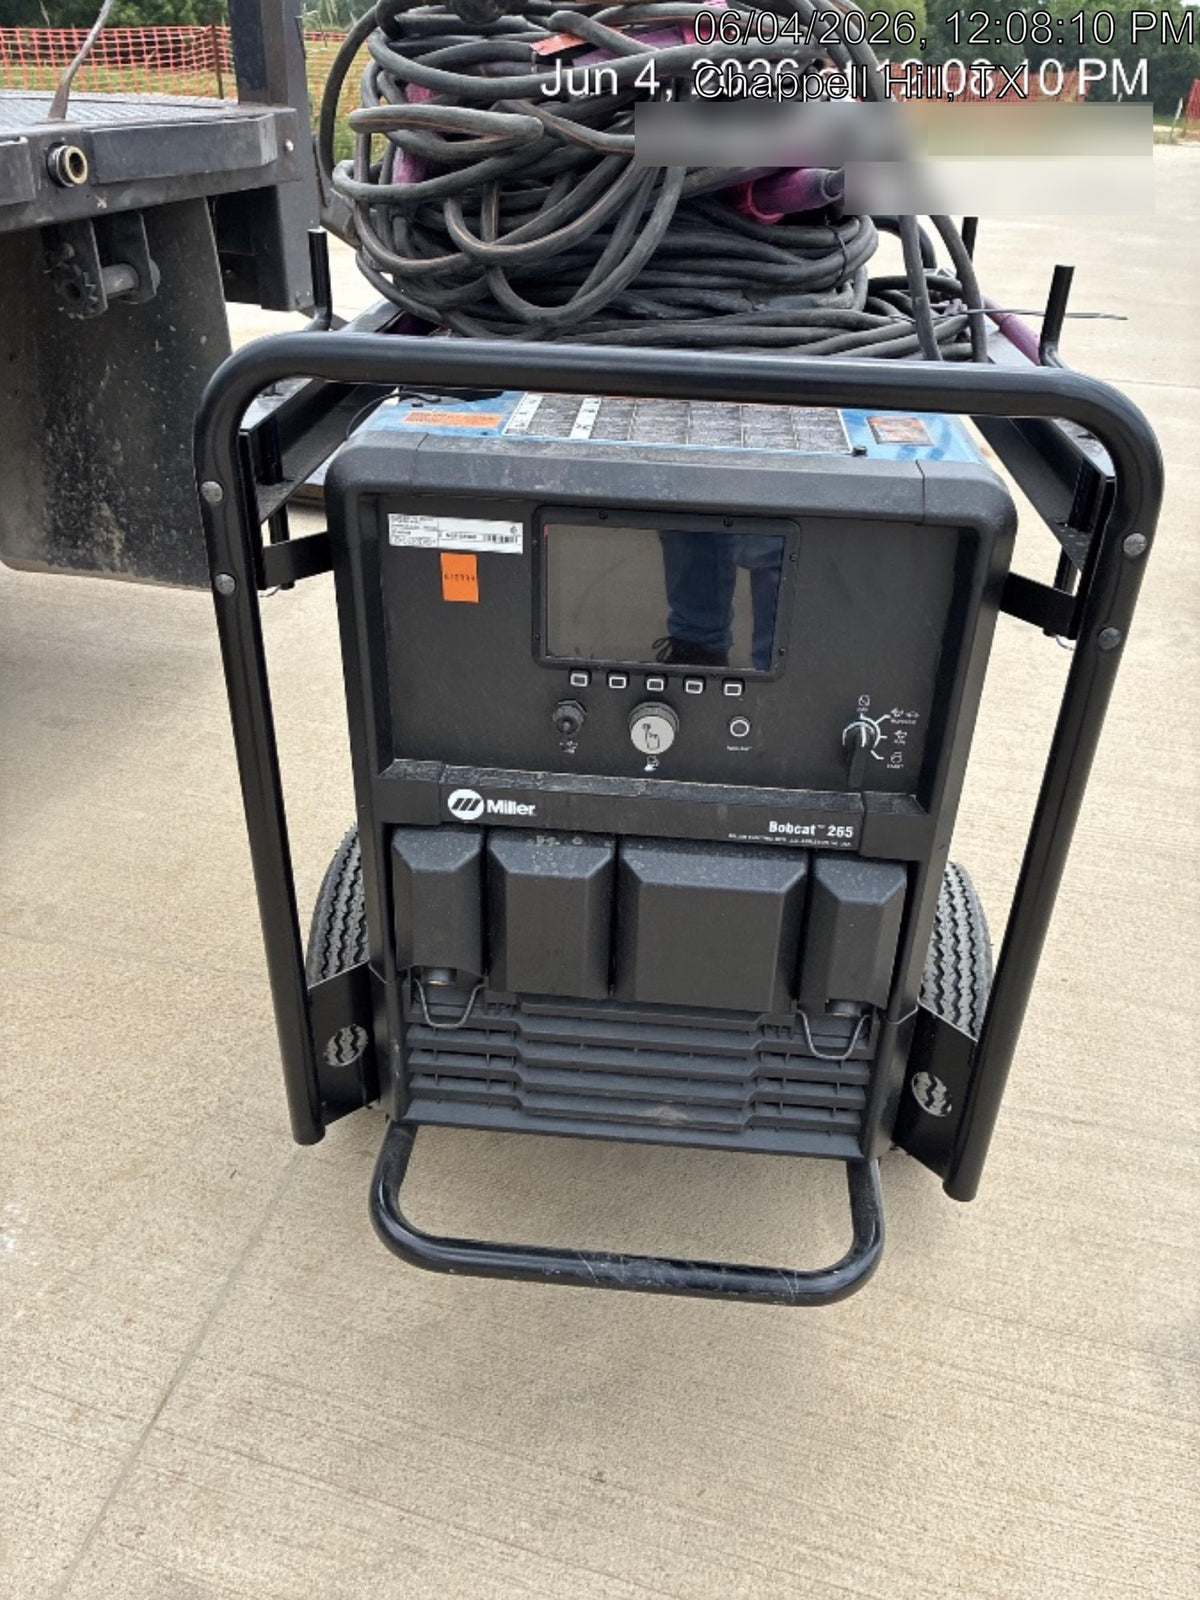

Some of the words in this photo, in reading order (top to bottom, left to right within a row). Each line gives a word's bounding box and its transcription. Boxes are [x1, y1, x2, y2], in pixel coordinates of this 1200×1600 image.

[486, 799, 536, 816] Miller
[768, 820, 817, 836] Bobcat
[826, 824, 854, 838] 265
